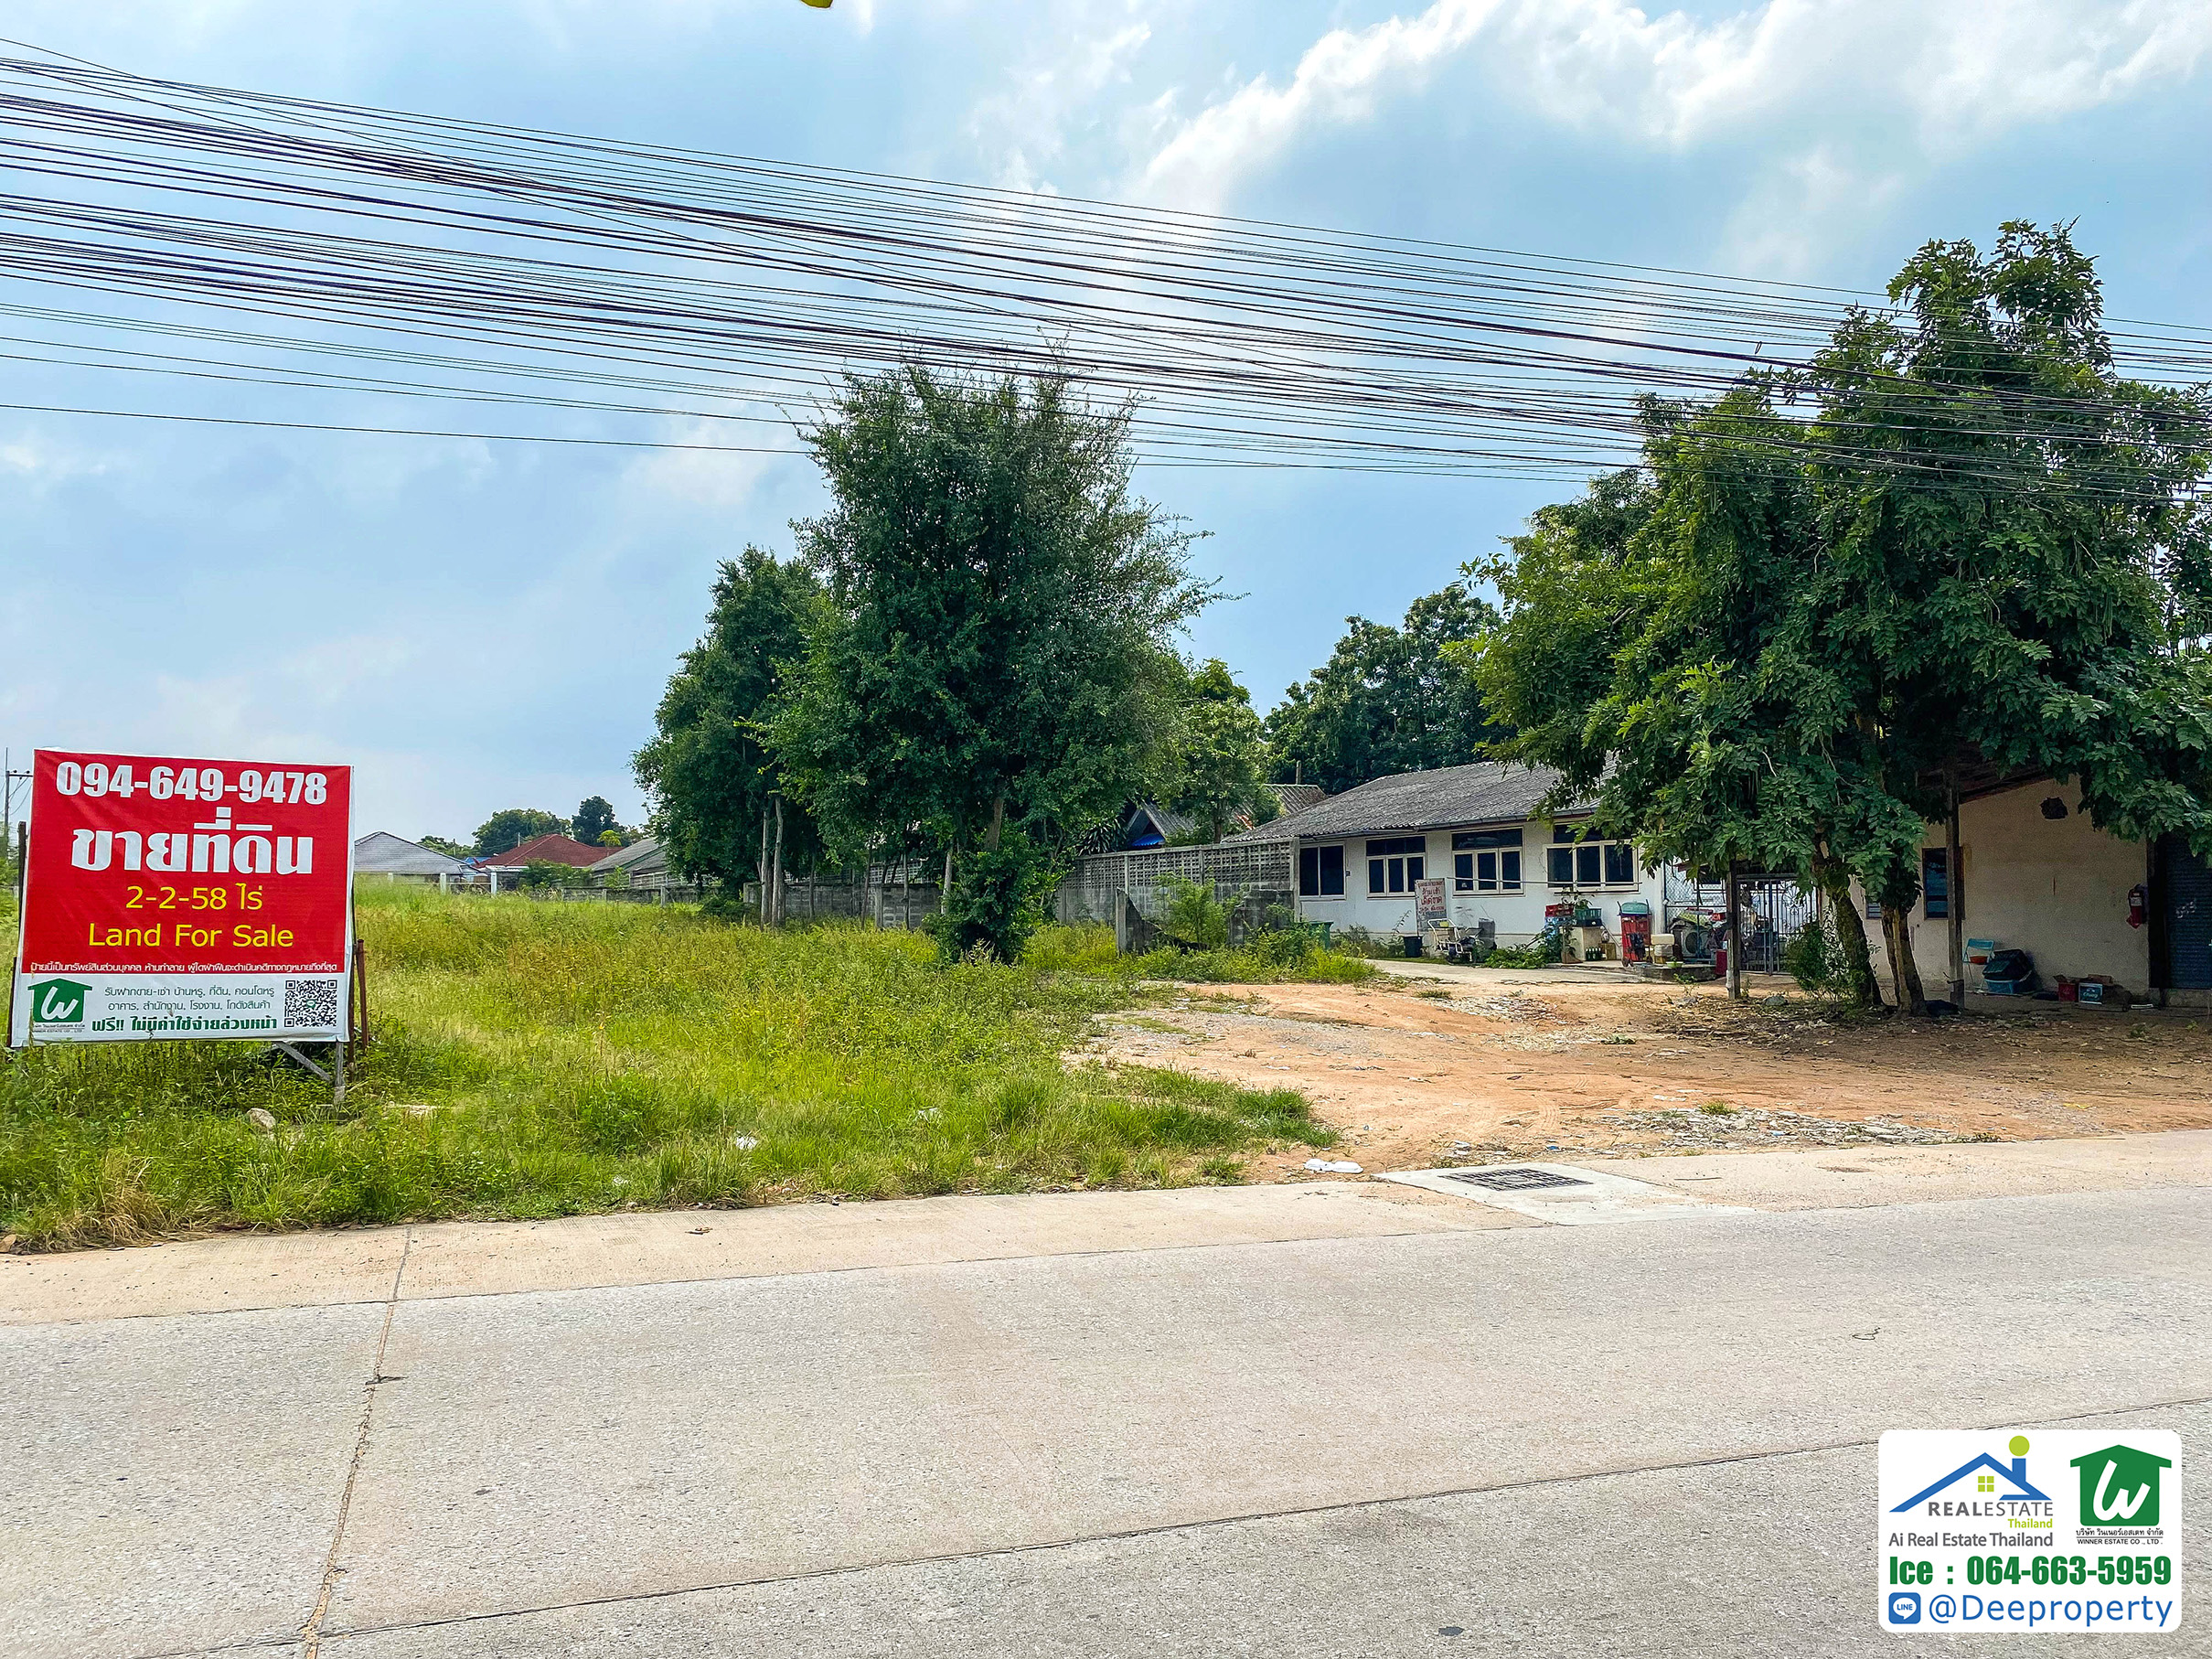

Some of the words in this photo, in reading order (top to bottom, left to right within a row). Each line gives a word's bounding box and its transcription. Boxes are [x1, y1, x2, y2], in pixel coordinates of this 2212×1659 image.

[56, 761, 327, 805] 094-649-9478
[71, 807, 313, 875] ขายที่ดิน
[125, 885, 227, 910] 2-2-58
[236, 883, 263, 910] ไร่
[89, 924, 160, 947] Land
[176, 925, 222, 947] For
[232, 925, 294, 947] Sale
[144, 962, 185, 972] ห้ามทำลาย
[227, 1000, 271, 1011] โกดังสินค้า
[91, 1016, 123, 1032] ฟรี!!
[130, 1015, 277, 1031] ไม่มีค่าใช้จ่ายล่วงหน้า
